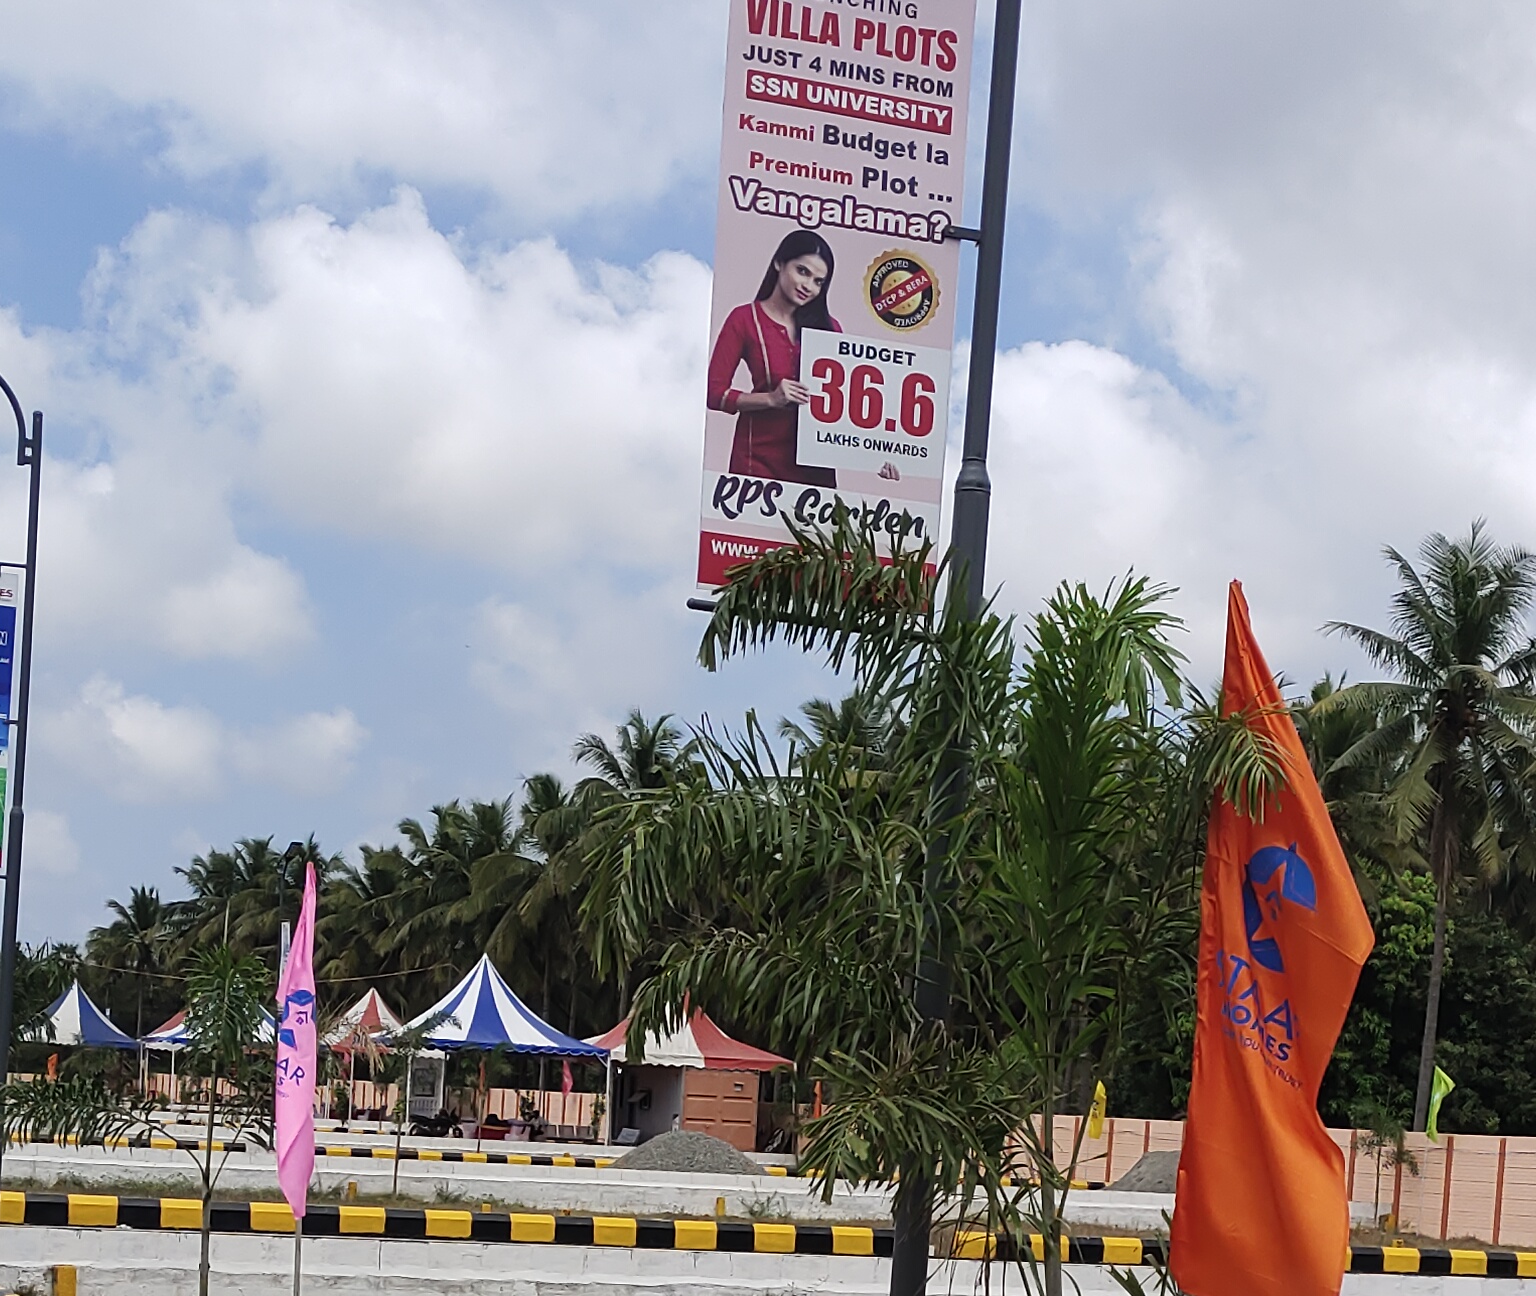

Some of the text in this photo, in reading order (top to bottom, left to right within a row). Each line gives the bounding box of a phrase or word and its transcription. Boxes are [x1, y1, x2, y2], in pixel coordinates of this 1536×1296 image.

[745, 0, 958, 73] VILLA PLOTS
[742, 44, 954, 98] JUST 4 MINS FROM
[750, 74, 950, 127] SSN UNIVERSITY
[738, 113, 950, 166] Kammi Budget la
[748, 150, 853, 186] Premium
[861, 165, 919, 198] Plot
[728, 174, 952, 245] Vangalama?
[872, 259, 909, 288] APPROVED
[874, 275, 929, 311] DTCP & RERA
[894, 299, 931, 327] APPROVED
[837, 340, 916, 367] BUDGET
[809, 357, 937, 438] 36.6
[816, 430, 928, 459] LAKHS ONWARDS
[712, 474, 784, 520] RPS
